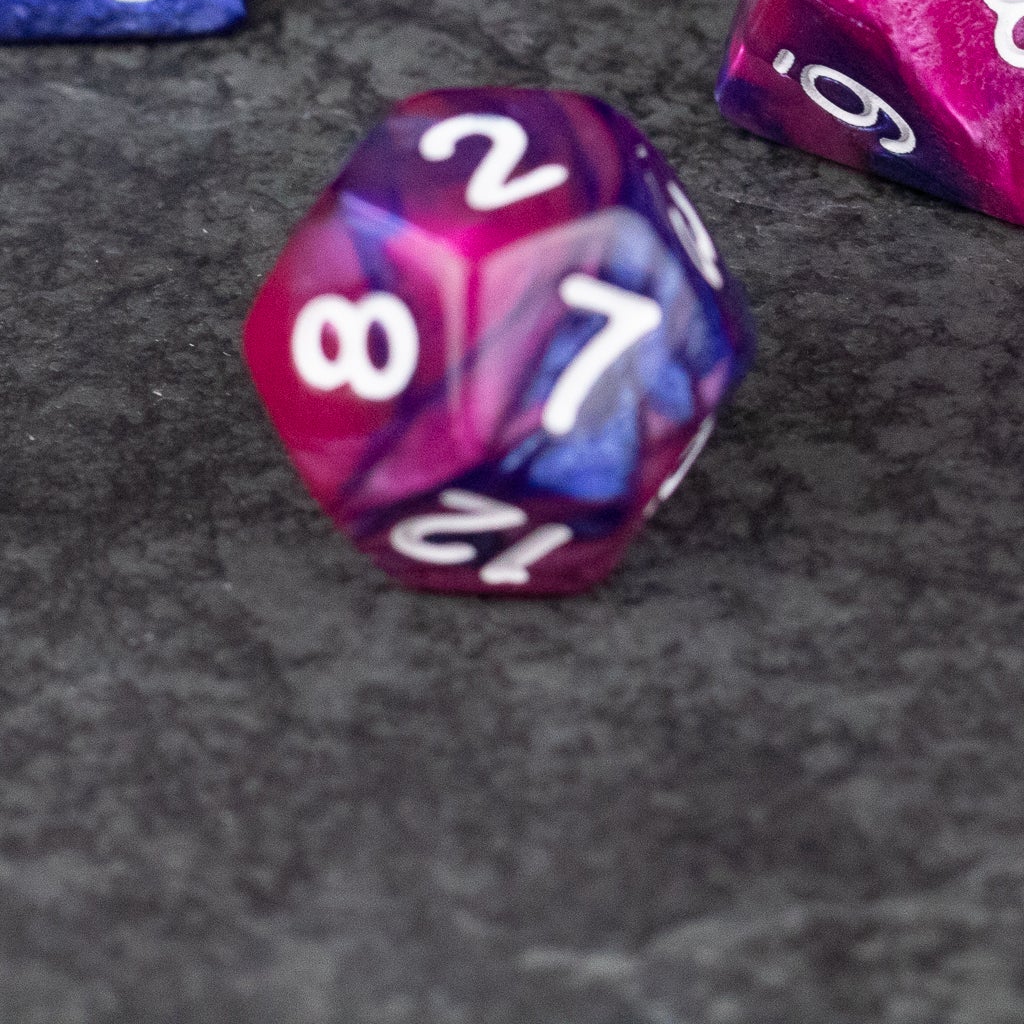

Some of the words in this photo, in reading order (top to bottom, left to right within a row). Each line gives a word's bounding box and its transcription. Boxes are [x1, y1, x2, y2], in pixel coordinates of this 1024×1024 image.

[419, 113, 569, 211] 2
[291, 291, 420, 402] 8
[541, 273, 664, 436] 7
[390, 488, 573, 585] 12
